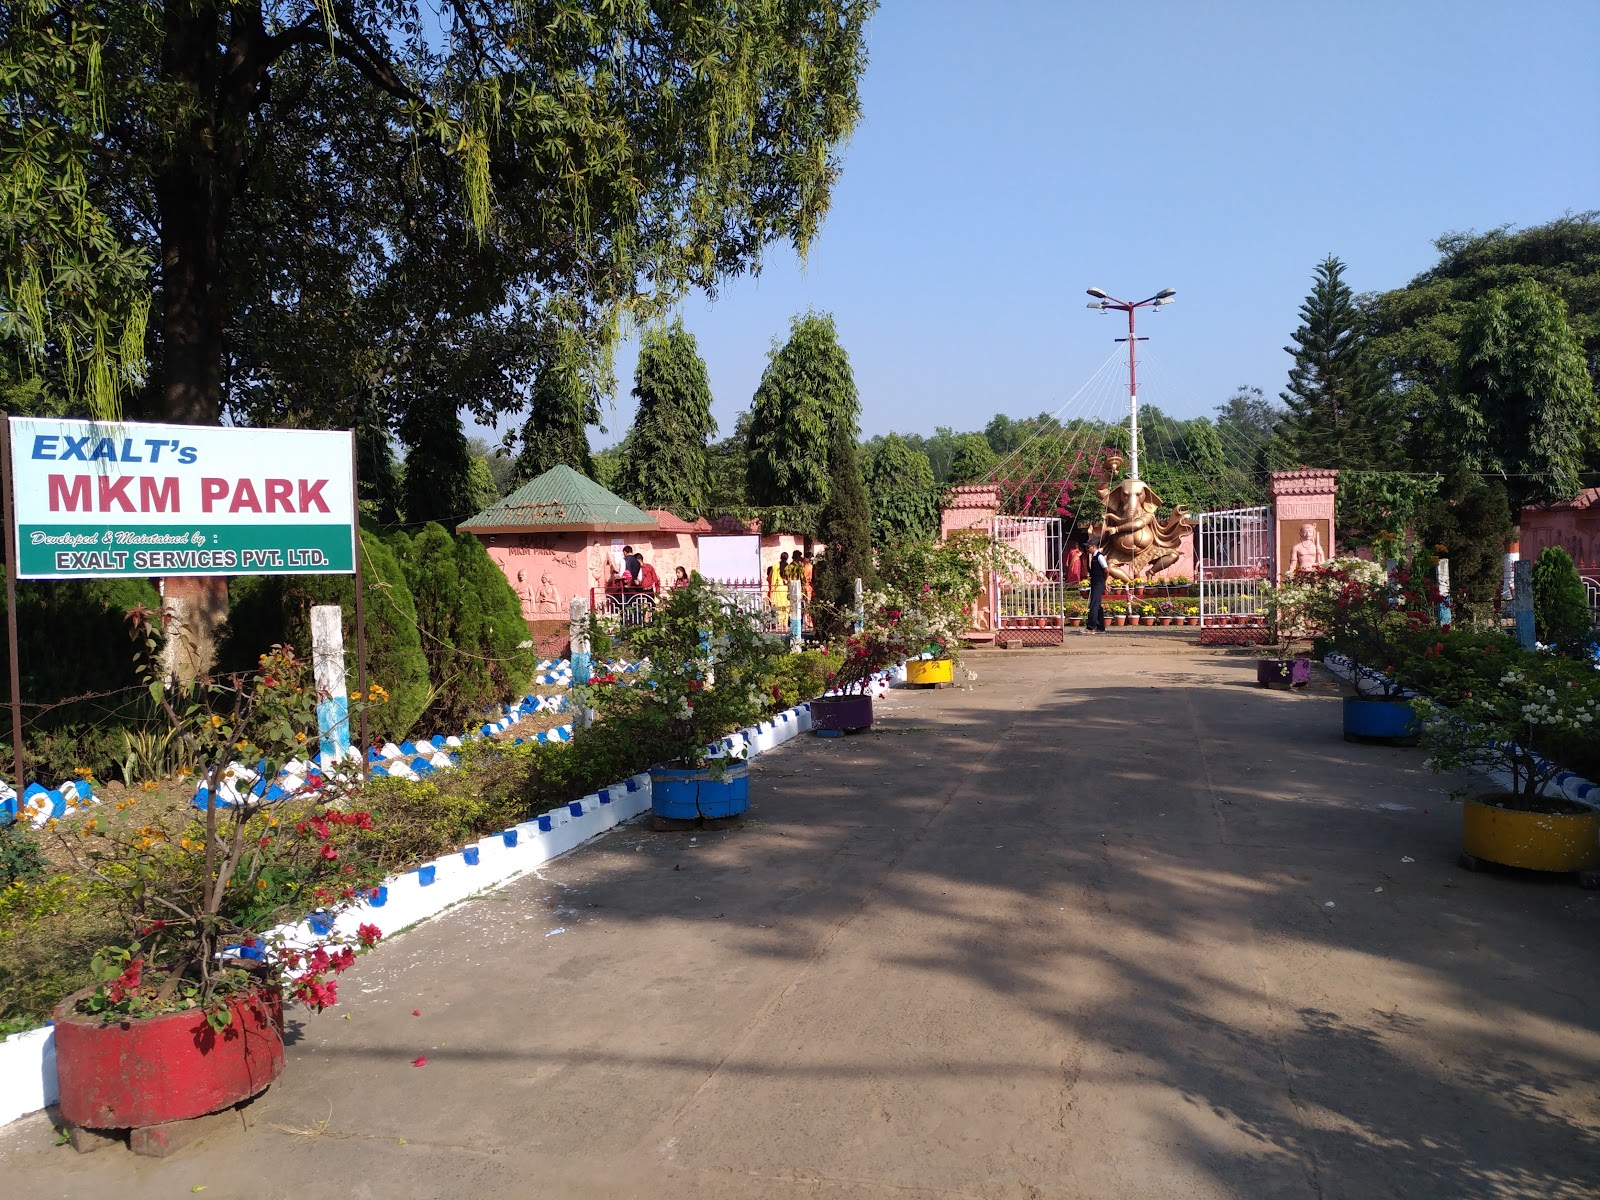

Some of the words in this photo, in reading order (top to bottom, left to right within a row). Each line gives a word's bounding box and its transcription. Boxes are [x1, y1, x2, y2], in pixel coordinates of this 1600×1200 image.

[32, 436, 198, 464] EXALT's
[48, 475, 181, 513] MKM
[201, 478, 331, 513] PARK
[30, 531, 98, 546] Developed
[102, 531, 113, 544] &
[115, 532, 188, 544] Maintained
[55, 551, 129, 570] EXALT
[133, 550, 238, 570] SERVICES
[241, 550, 283, 567] PVT.
[288, 549, 329, 566] LTD.
